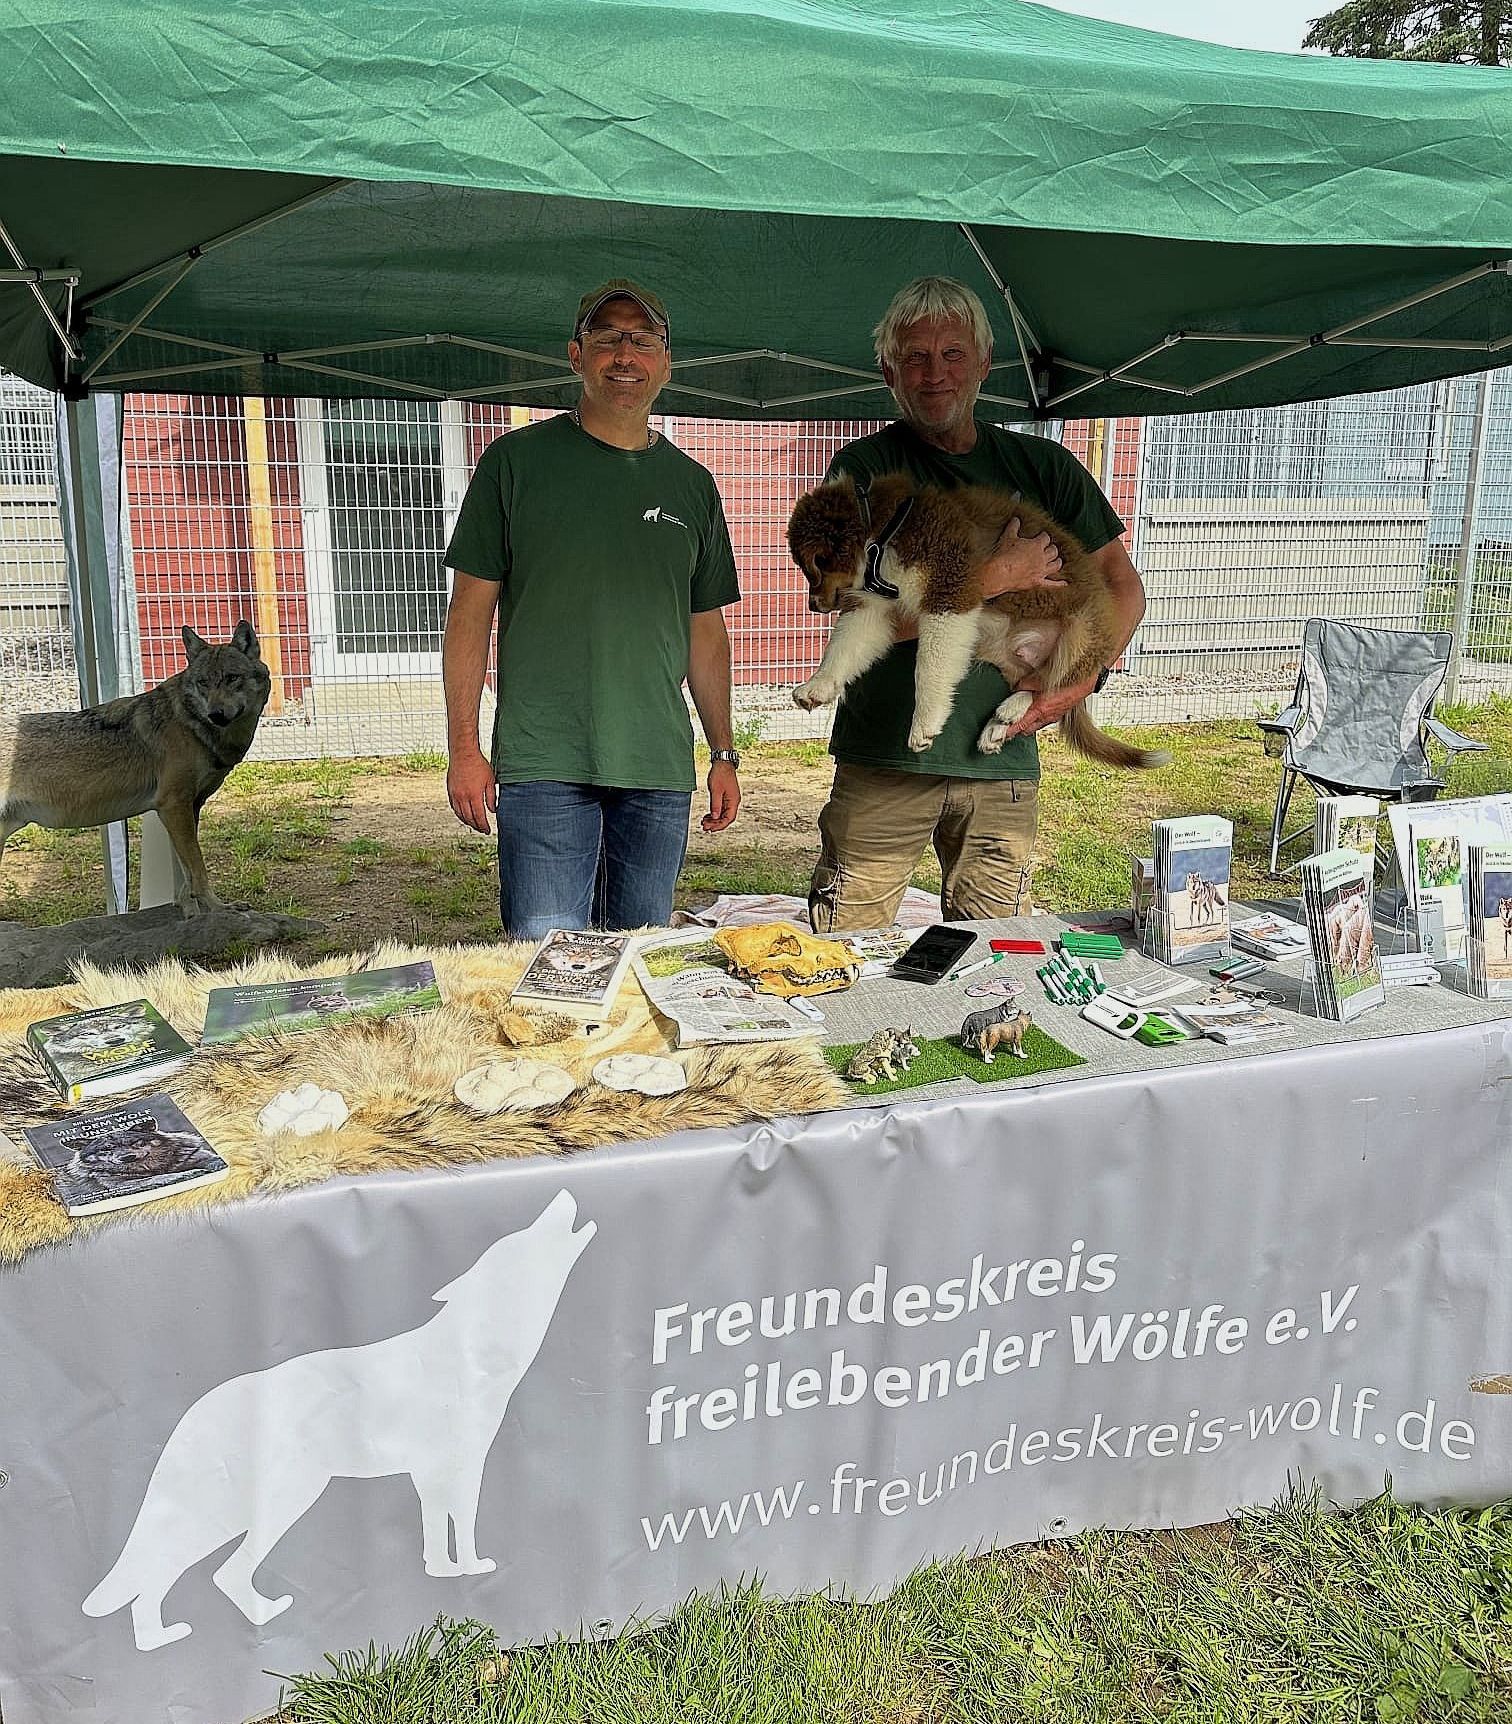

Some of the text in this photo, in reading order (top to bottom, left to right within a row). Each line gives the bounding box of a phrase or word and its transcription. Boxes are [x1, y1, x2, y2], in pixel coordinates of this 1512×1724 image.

[526, 972, 556, 982] DER
[559, 975, 609, 987] WÖLFE
[81, 1039, 156, 1061] WOLF
[53, 1108, 151, 1138] MIT DEM WOLF
[80, 1129, 108, 1138] UNS
[111, 1115, 154, 1132] LEBEN
[652, 1239, 1119, 1364] Freundeskreis
[646, 1284, 1360, 1445] freilebender Wölfe e.V.
[640, 1383, 1476, 1553] www.freundeskreis-wolf.de
